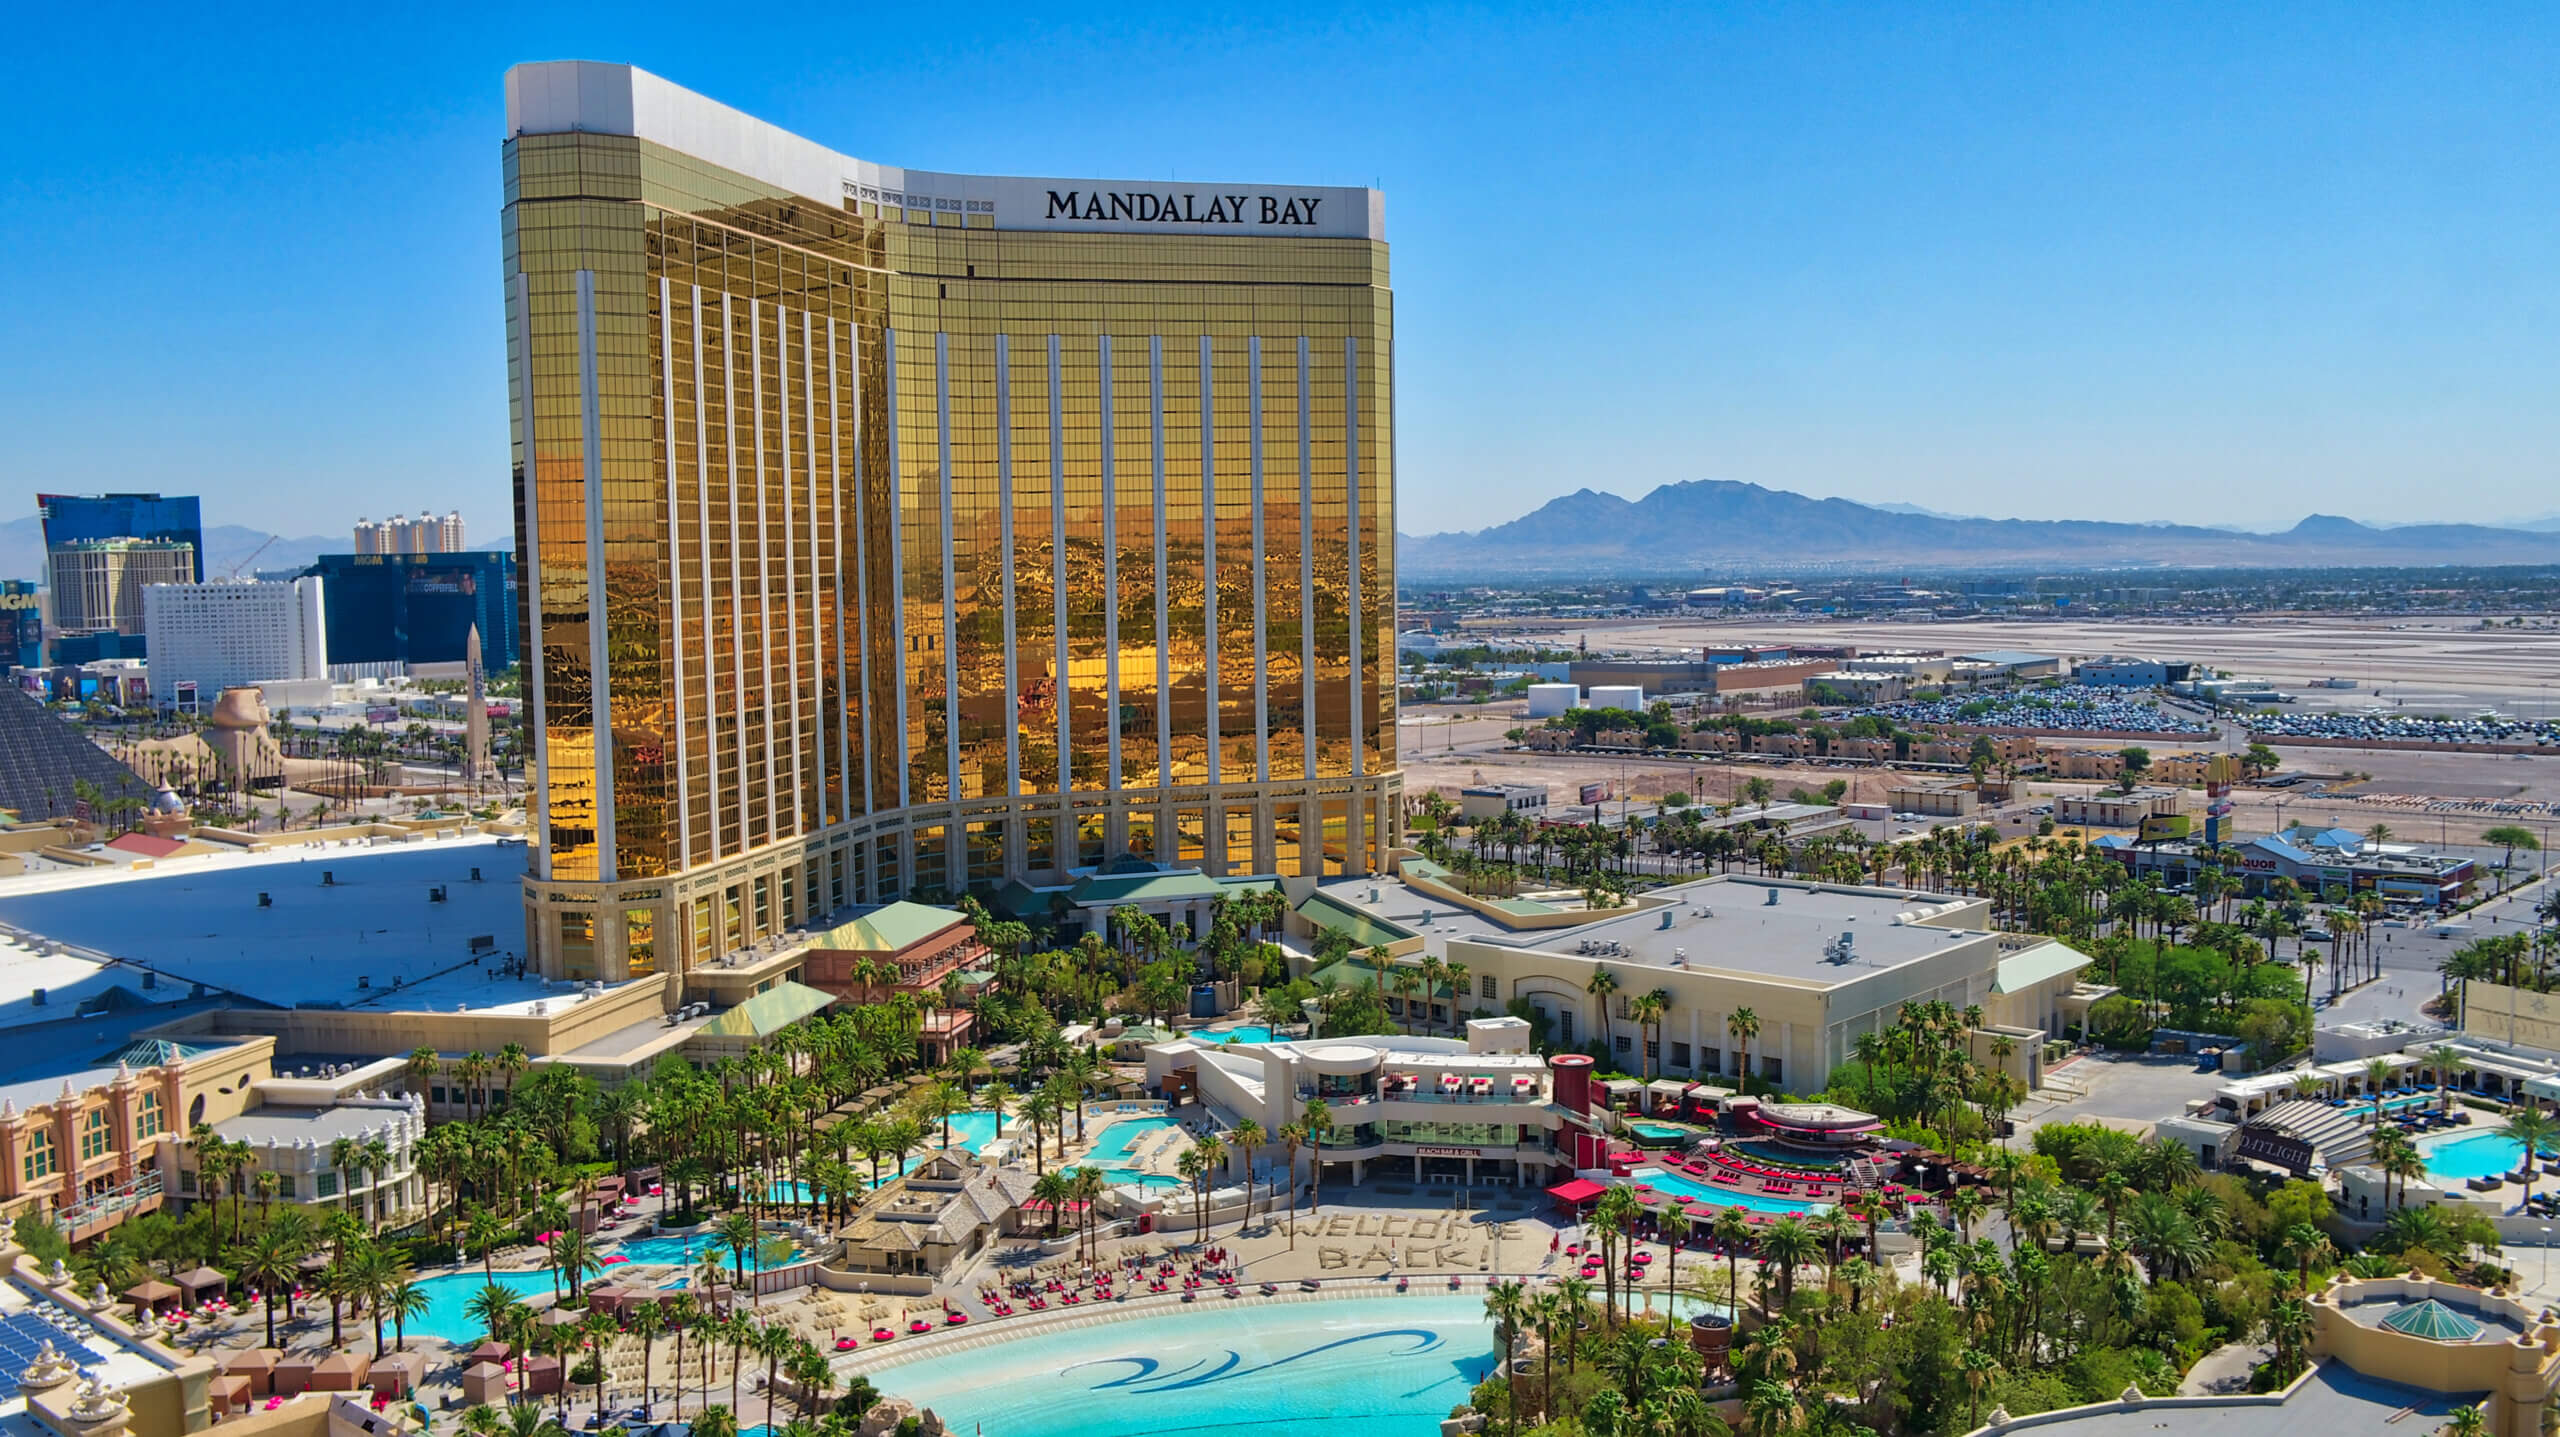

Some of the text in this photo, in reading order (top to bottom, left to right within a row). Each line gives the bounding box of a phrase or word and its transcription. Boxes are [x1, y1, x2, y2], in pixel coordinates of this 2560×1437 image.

[1045, 191, 1322, 225] MANDALAY BAY
[2240, 1135, 2310, 1166] DAYLIGHT
[1274, 1210, 1523, 1241] WELCOME
[1318, 1244, 1490, 1271] BACK!
